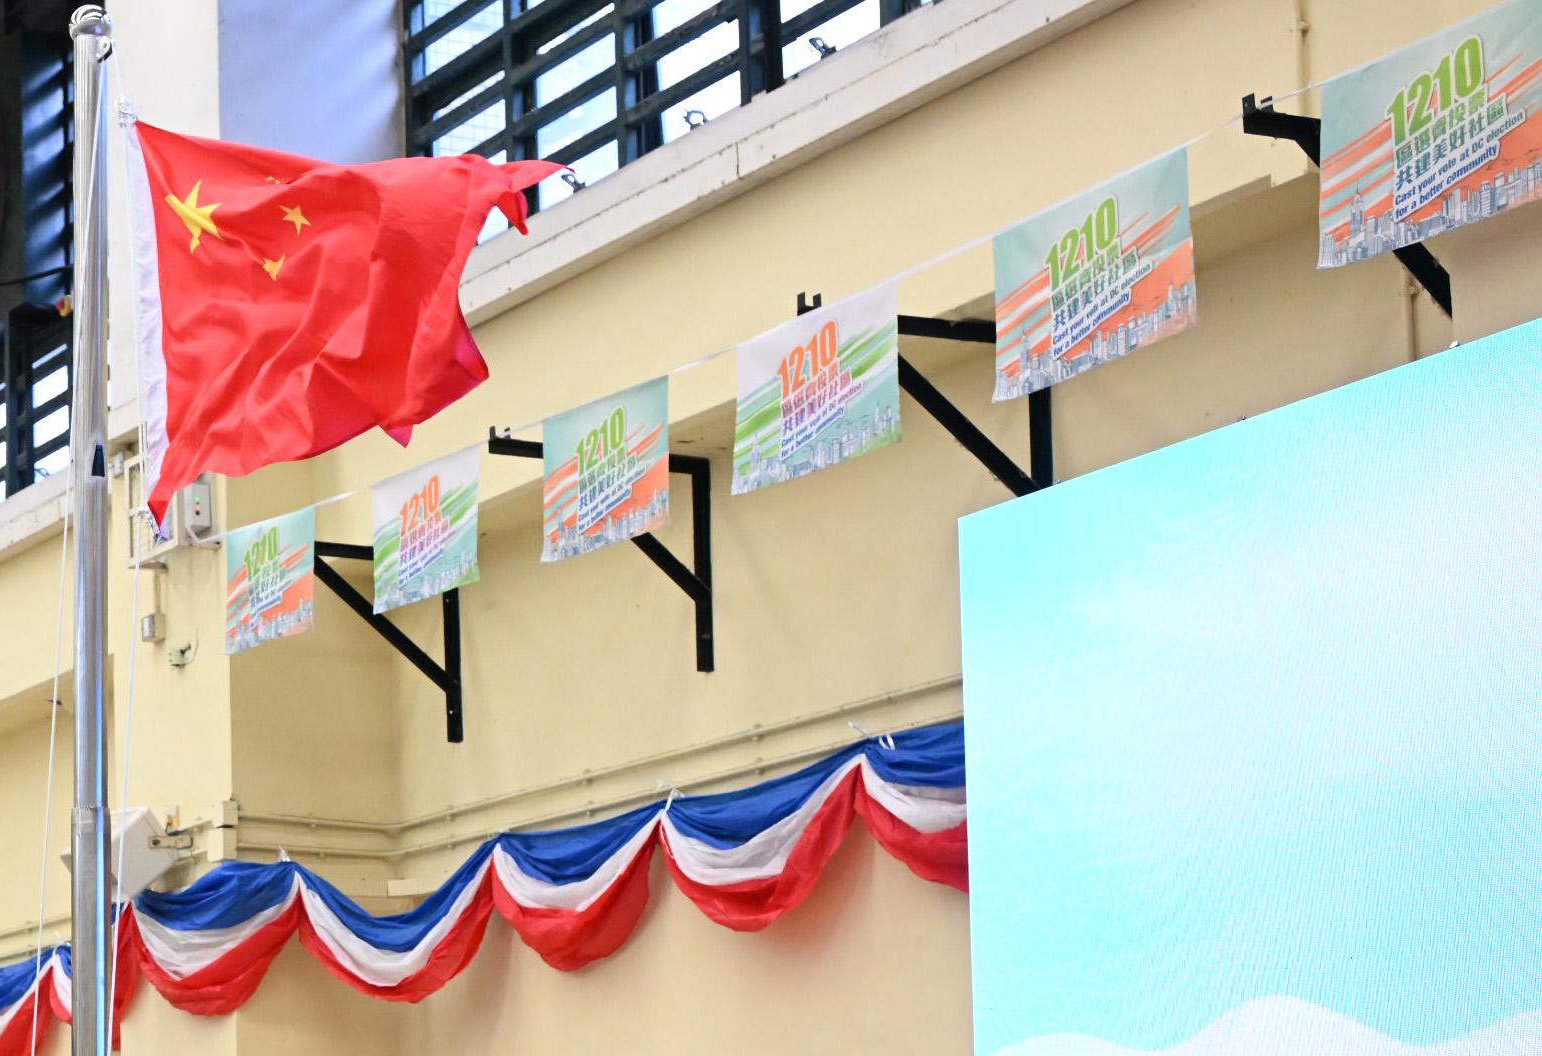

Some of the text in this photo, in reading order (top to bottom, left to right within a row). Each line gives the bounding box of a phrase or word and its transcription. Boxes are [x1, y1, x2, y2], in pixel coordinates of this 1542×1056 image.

[1387, 37, 1483, 145] 1210
[1395, 112, 1524, 205] Cast your vote at DC election
[1395, 144, 1498, 219] for a better community
[1396, 100, 1504, 191] 共建美好社區
[1045, 197, 1117, 292] 1210
[778, 320, 837, 401] 1210
[576, 408, 625, 474] 1210
[401, 474, 440, 537] 1210
